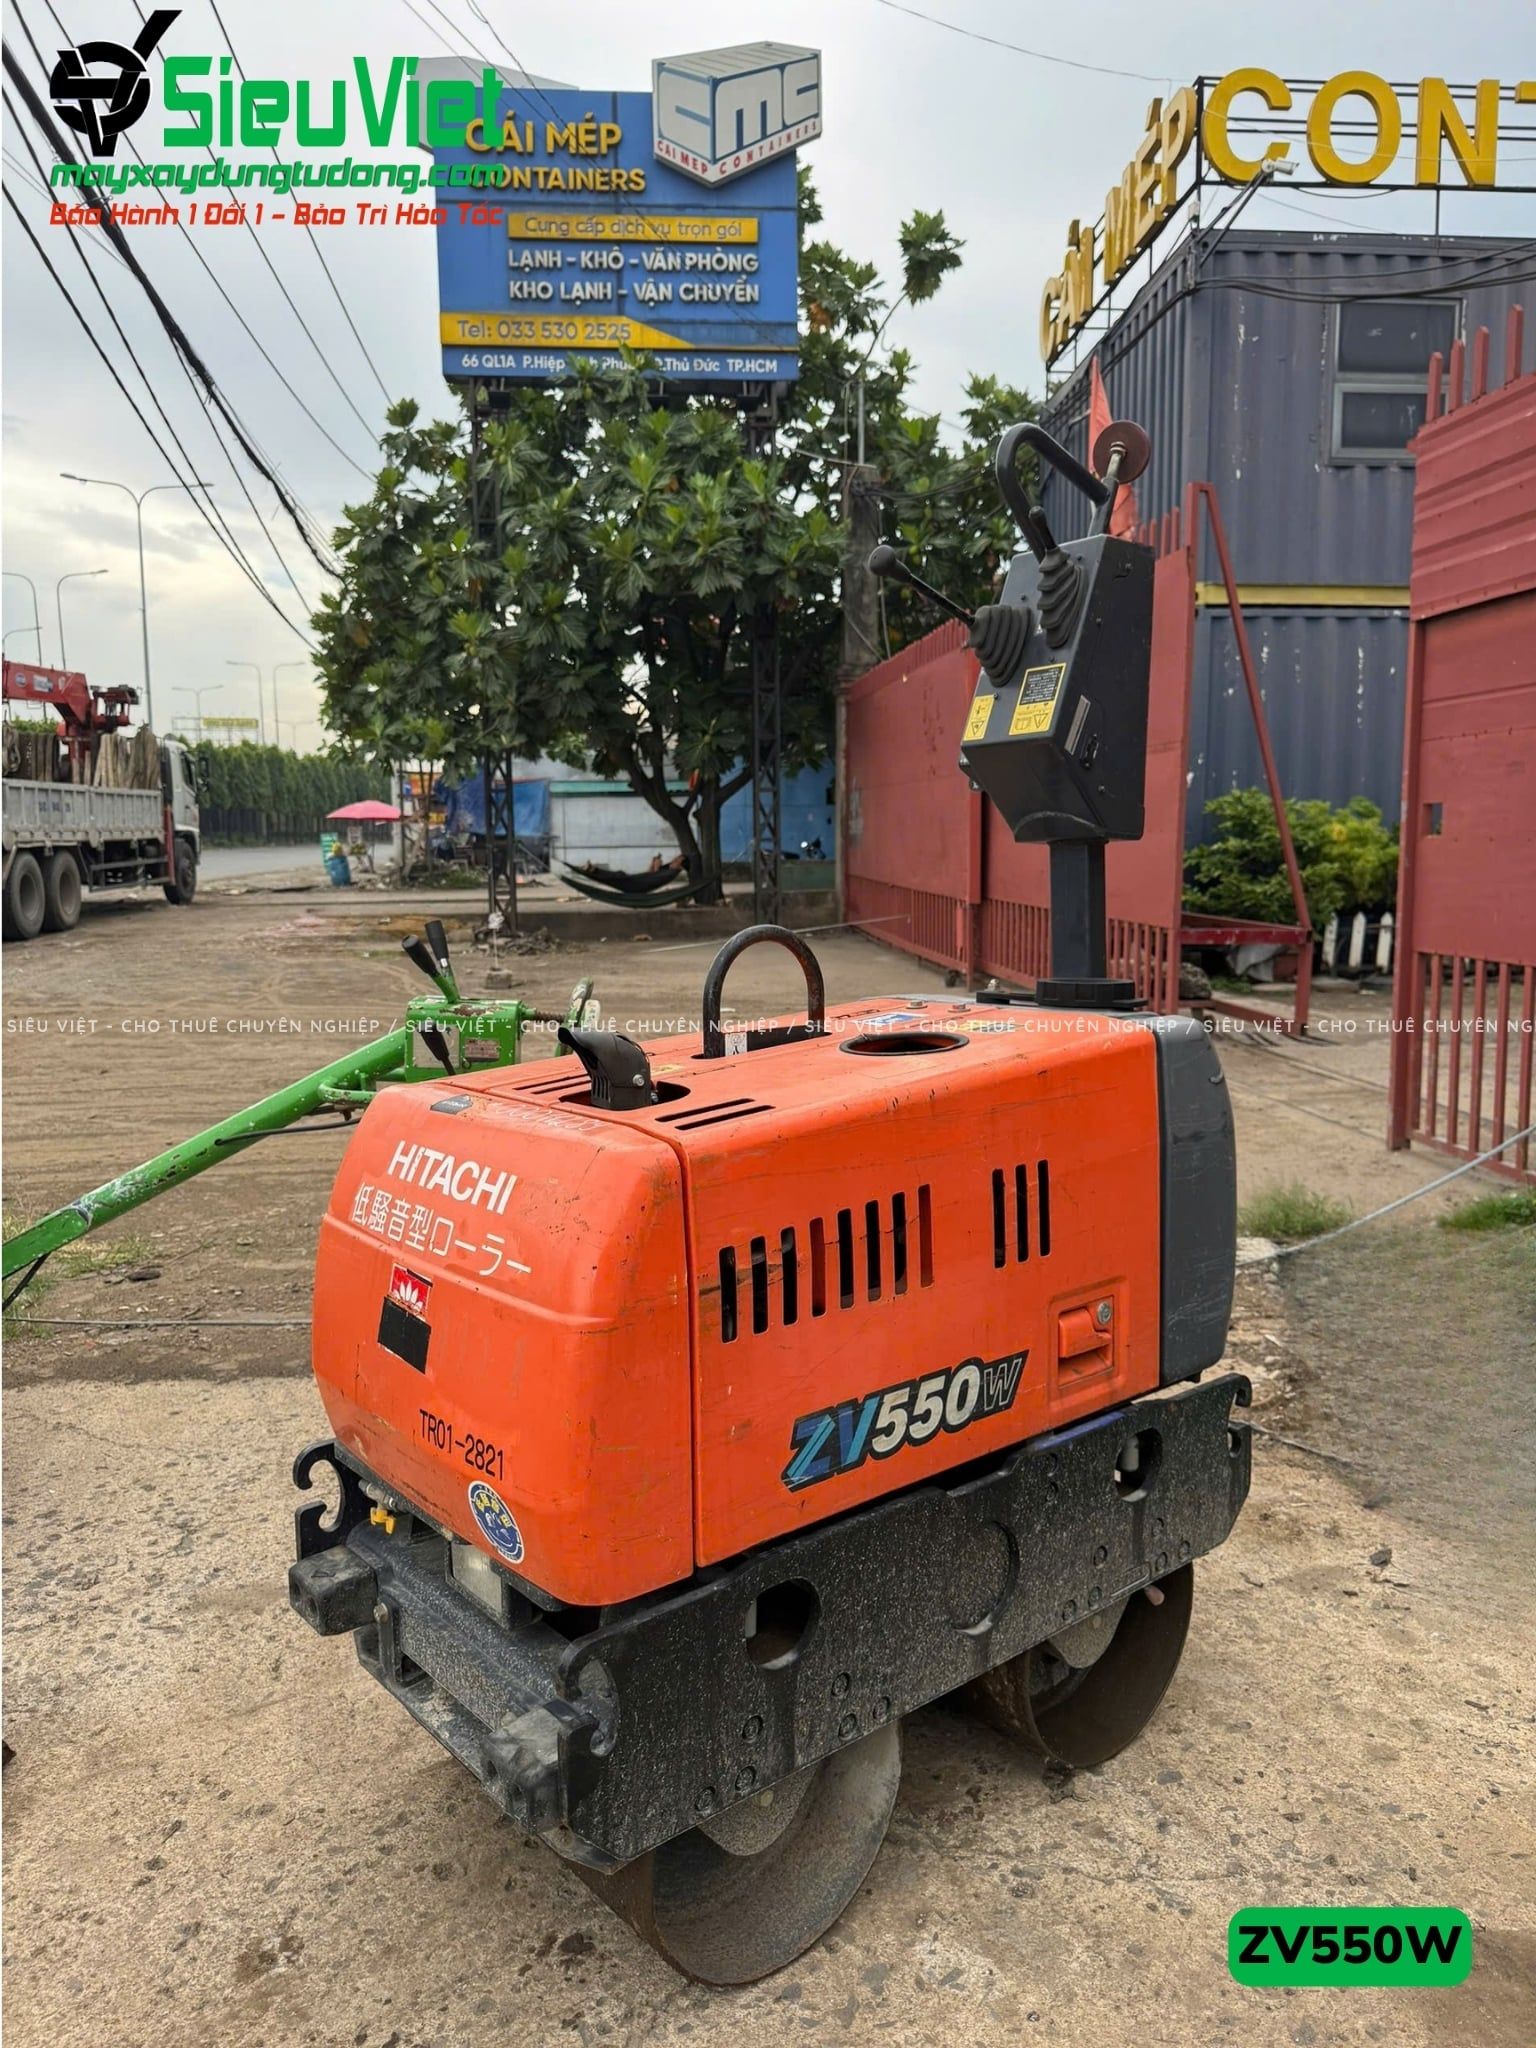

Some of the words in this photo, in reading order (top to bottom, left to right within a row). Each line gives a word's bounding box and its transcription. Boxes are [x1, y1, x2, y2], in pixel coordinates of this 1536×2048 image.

[546, 112, 623, 155] MÉP
[656, 140, 676, 159] CAI
[681, 152, 708, 174] MEP
[719, 121, 817, 175] CONTAINERS
[1203, 68, 1536, 187] CON
[525, 217, 570, 236] Cung
[575, 215, 606, 235] cấp
[610, 216, 645, 235] dịch
[652, 221, 671, 236] vụ
[679, 221, 712, 238] trọn
[719, 221, 742, 240] gói
[1039, 219, 1094, 363] CÁI
[1104, 97, 1197, 286] MÉP
[508, 249, 562, 272] LẠNH
[581, 246, 624, 269] KHÔ
[641, 247, 681, 271] VĂN
[685, 246, 759, 272] PHÒNG
[509, 281, 553, 299] KHO
[560, 281, 612, 306] LẠNH
[634, 278, 672, 307] VẬN
[679, 274, 759, 302] CHUYỂN
[458, 319, 492, 338] Tel:
[498, 320, 535, 339] 033
[541, 321, 577, 340] 530
[584, 323, 631, 340] 2525
[461, 354, 479, 368] 66
[482, 354, 516, 369] QL1A
[523, 355, 566, 372] P.Hiệp
[693, 357, 720, 372] Đức
[727, 358, 777, 373] TP.HCM
[387, 1140, 518, 1215] HITACHI
[783, 1355, 1024, 1485] ZV550W
[420, 1408, 503, 1481] TR01-2821
